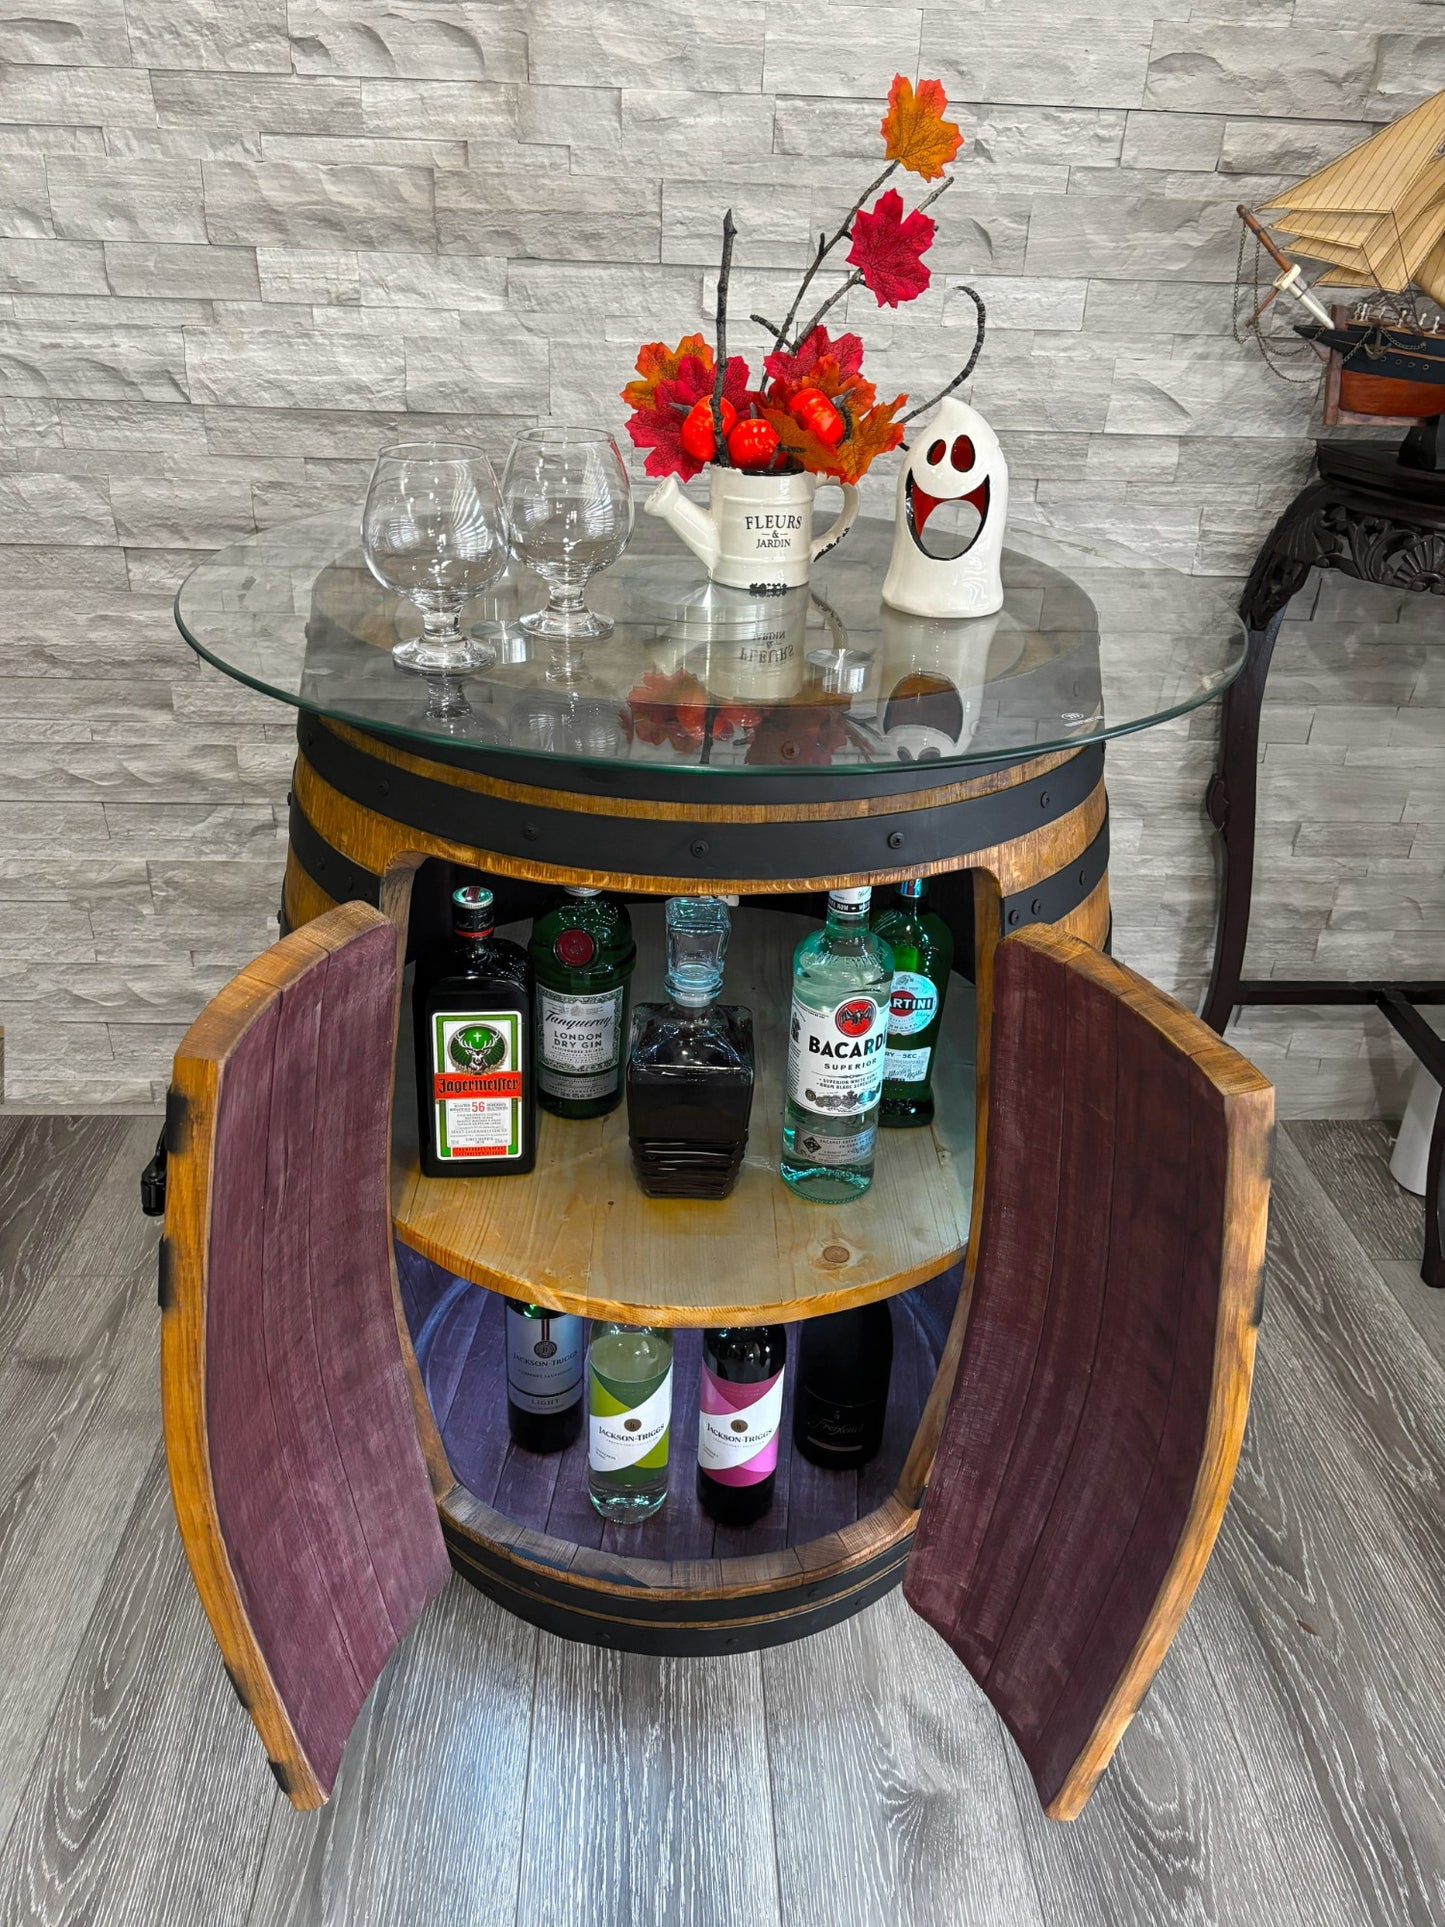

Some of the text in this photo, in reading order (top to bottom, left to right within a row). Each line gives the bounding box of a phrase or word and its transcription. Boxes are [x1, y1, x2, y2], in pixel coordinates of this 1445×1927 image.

[745, 515, 802, 530] FLEURS
[772, 530, 779, 538] &
[756, 539, 791, 549] JARDIN
[890, 997, 933, 1009] RTINI
[545, 1009, 613, 1030] Tanqueray
[554, 1031, 602, 1041] LONDON
[554, 1039, 602, 1048] DRY GIN
[824, 1058, 877, 1070] SUPERIOR
[472, 1101, 485, 1112] 56
[599, 1423, 665, 1442] JACKSON-TRIGGS
[706, 1423, 772, 1443] JACKSON-TRIGGS
